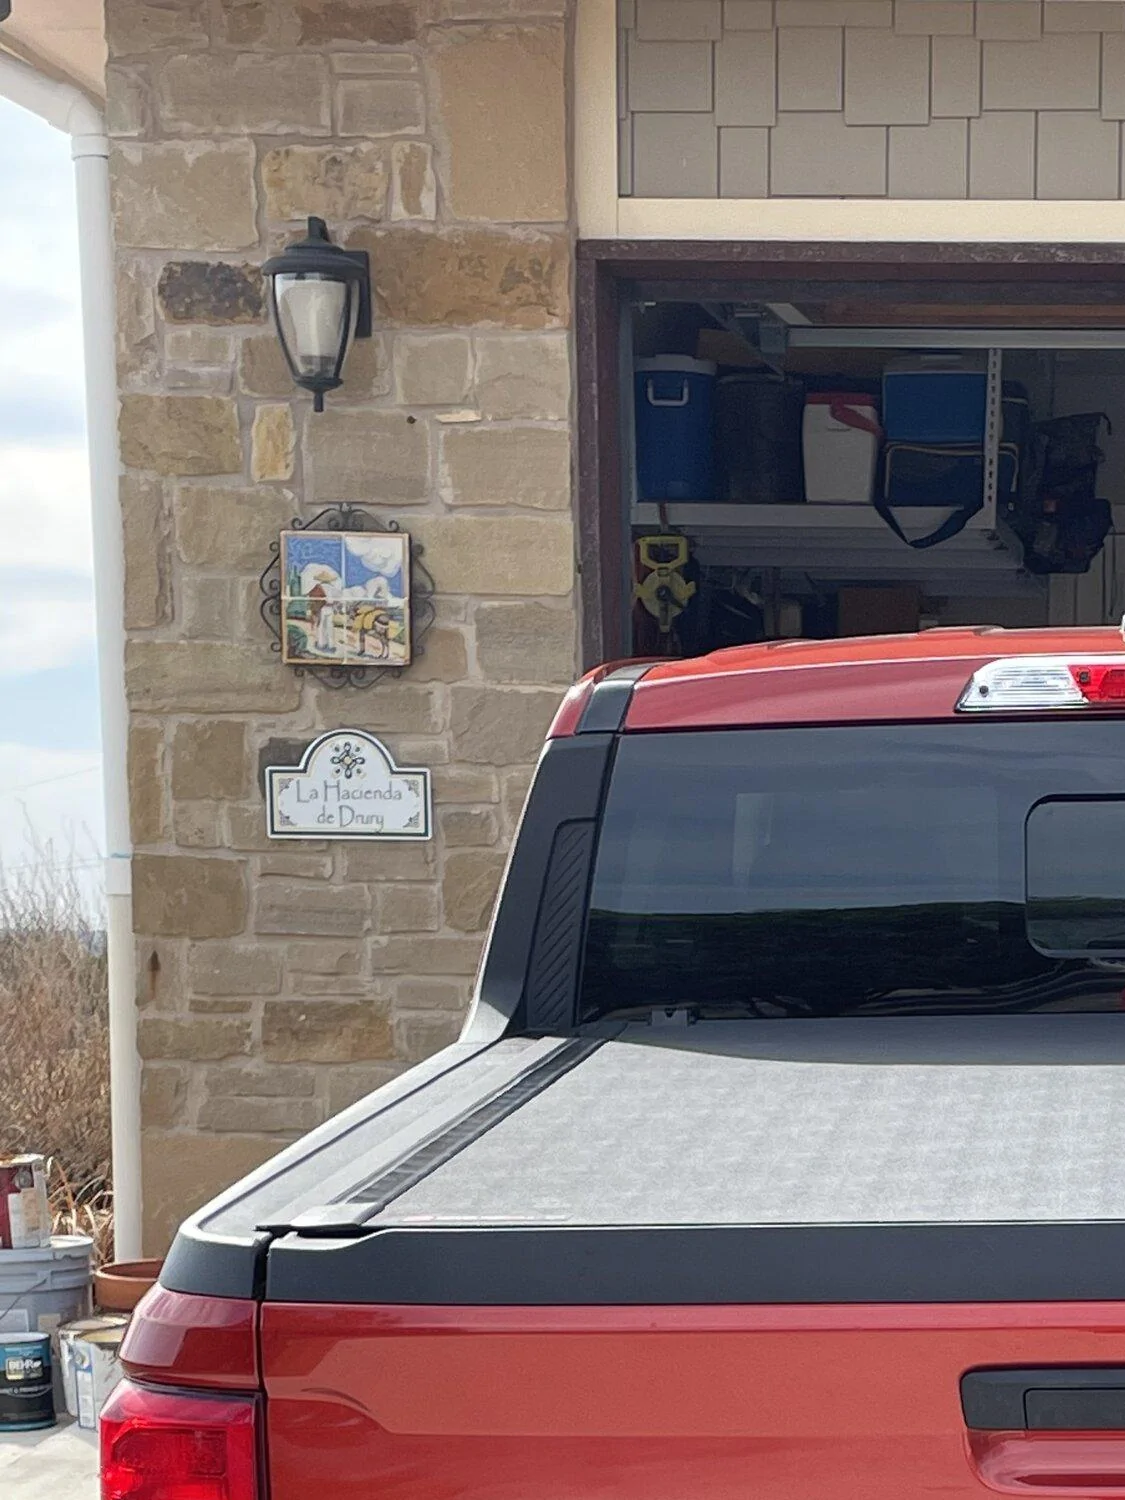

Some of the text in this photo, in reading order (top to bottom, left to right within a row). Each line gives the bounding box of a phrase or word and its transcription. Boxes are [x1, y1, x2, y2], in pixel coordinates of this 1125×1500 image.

[296, 779, 402, 803] La Hacienda
[317, 805, 335, 824] de
